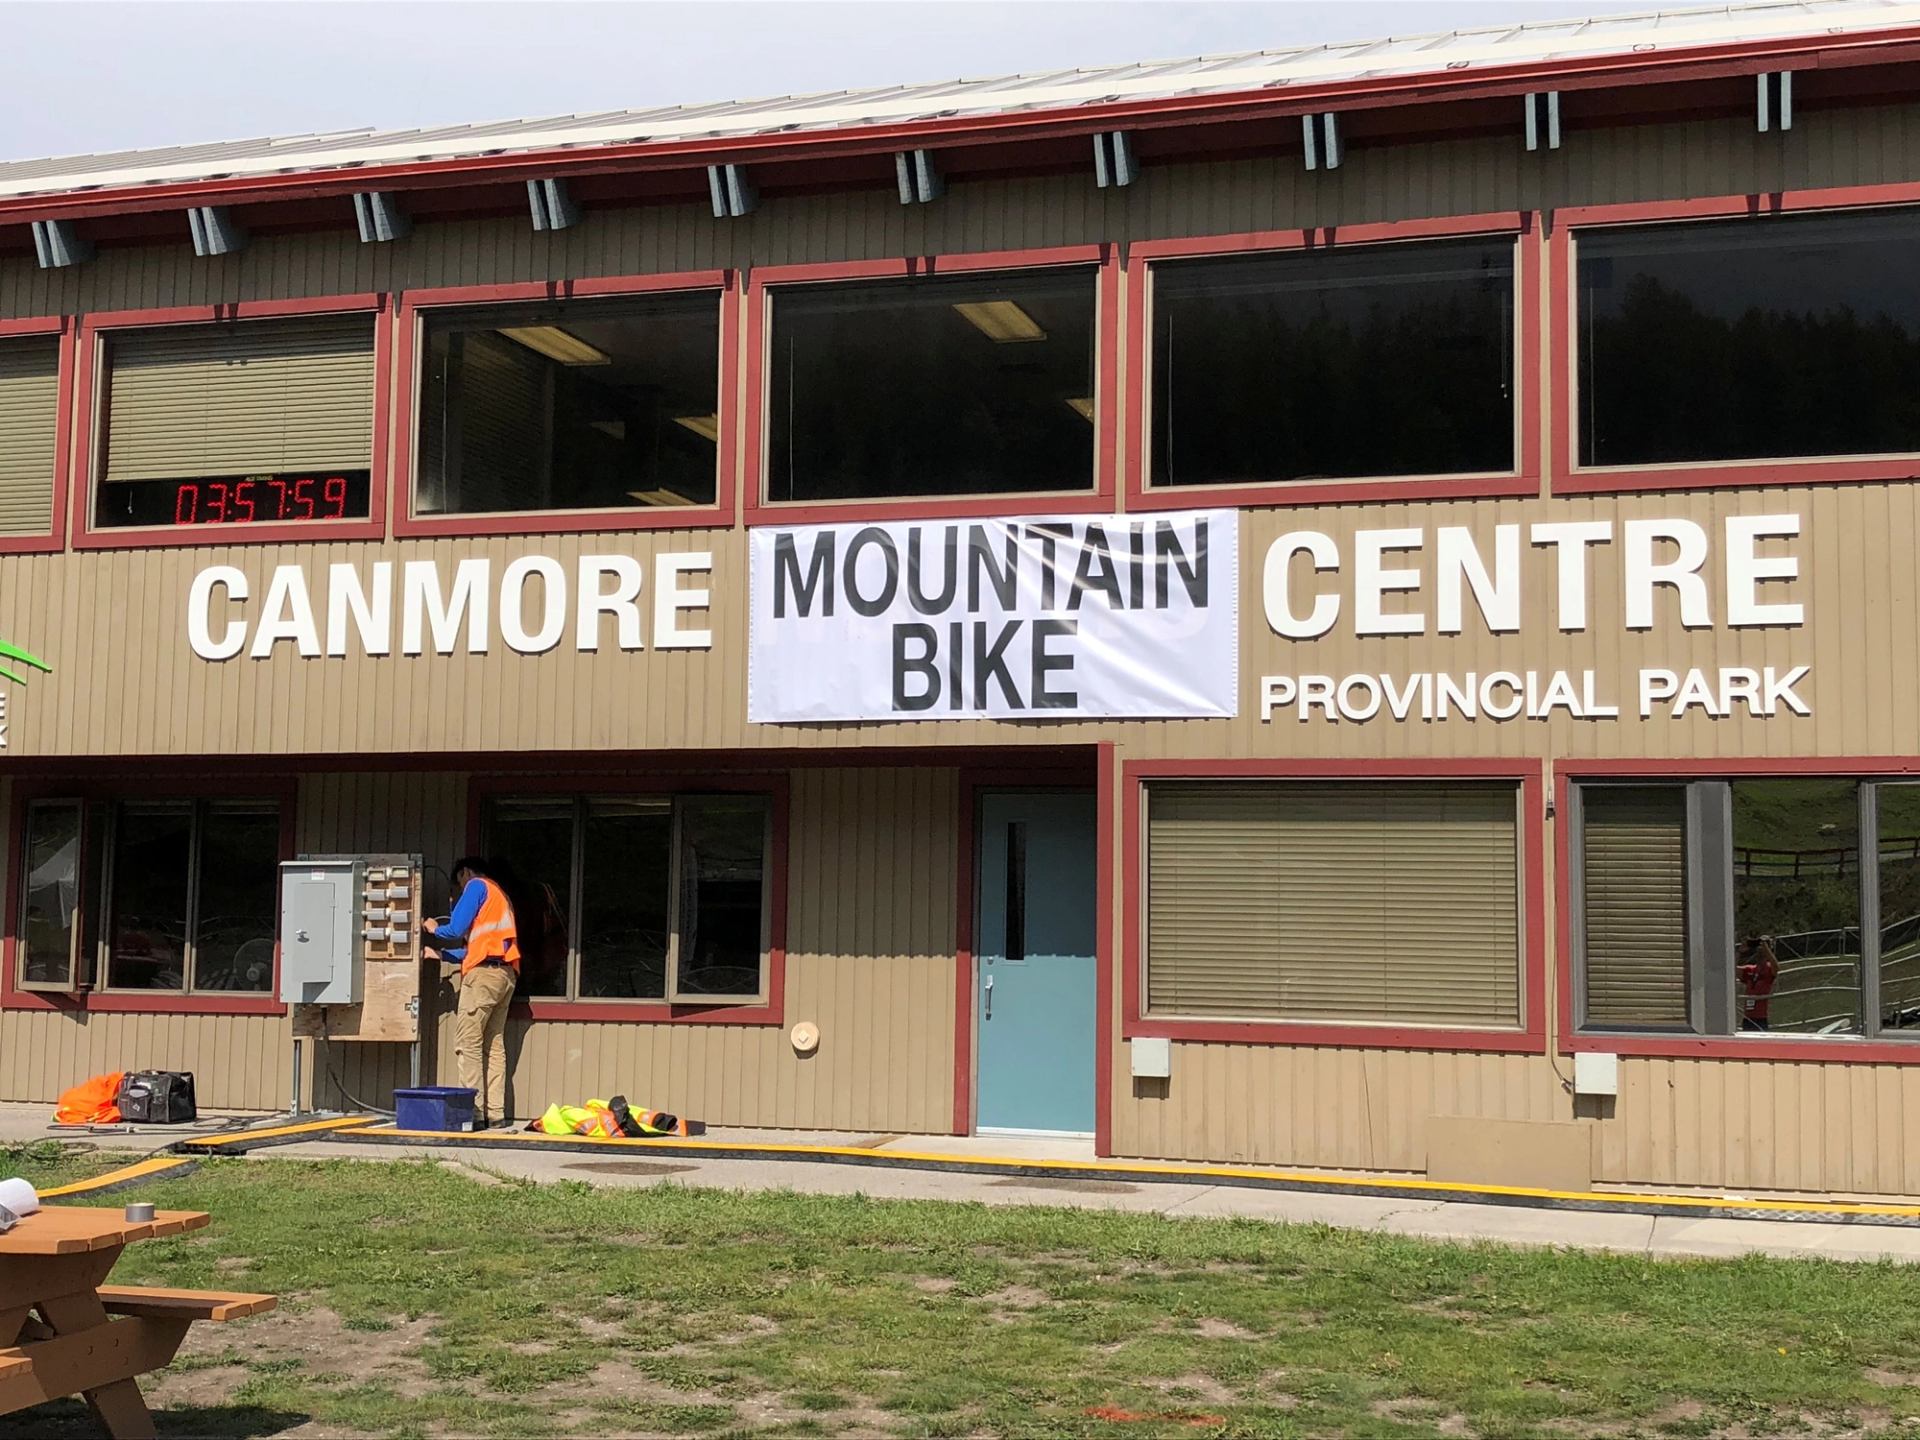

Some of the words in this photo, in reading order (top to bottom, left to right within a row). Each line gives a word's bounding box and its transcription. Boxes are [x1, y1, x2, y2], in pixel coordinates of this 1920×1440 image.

[176, 479, 347, 525] 03:57:59
[188, 551, 713, 660] CANMORE
[774, 517, 1209, 619] MOUNTAIN
[1262, 514, 1804, 638] CENTRE
[892, 619, 1079, 712] BIKE
[1261, 671, 1619, 722] PROVINCIAL
[1639, 666, 1811, 716] PARK
